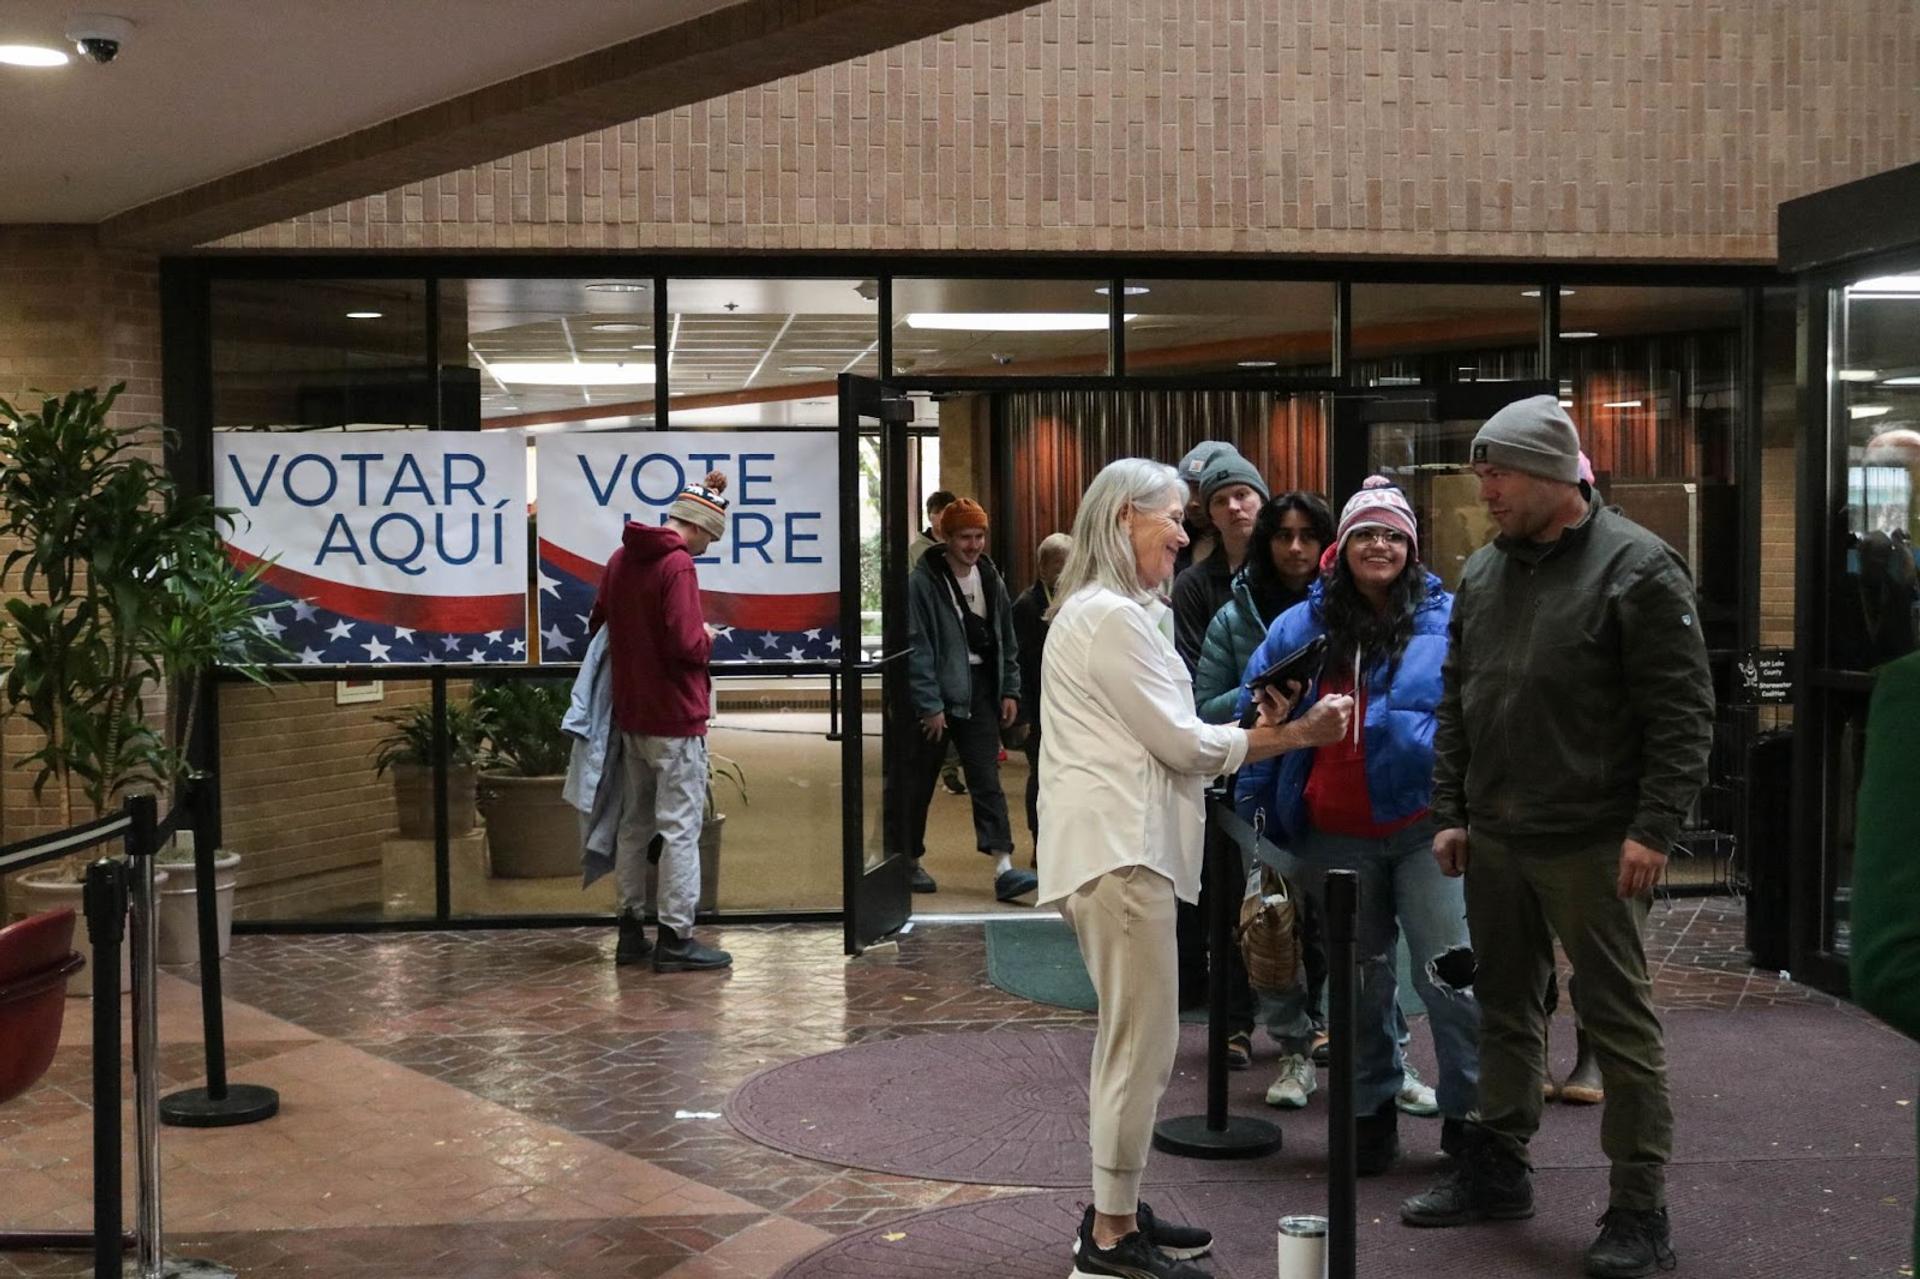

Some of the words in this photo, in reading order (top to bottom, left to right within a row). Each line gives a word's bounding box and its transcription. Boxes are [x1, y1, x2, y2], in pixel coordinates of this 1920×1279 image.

[228, 454, 487, 506] VOTAR
[577, 453, 776, 506] VOTE
[315, 499, 510, 575] AQUÍ
[624, 512, 822, 564] RE
